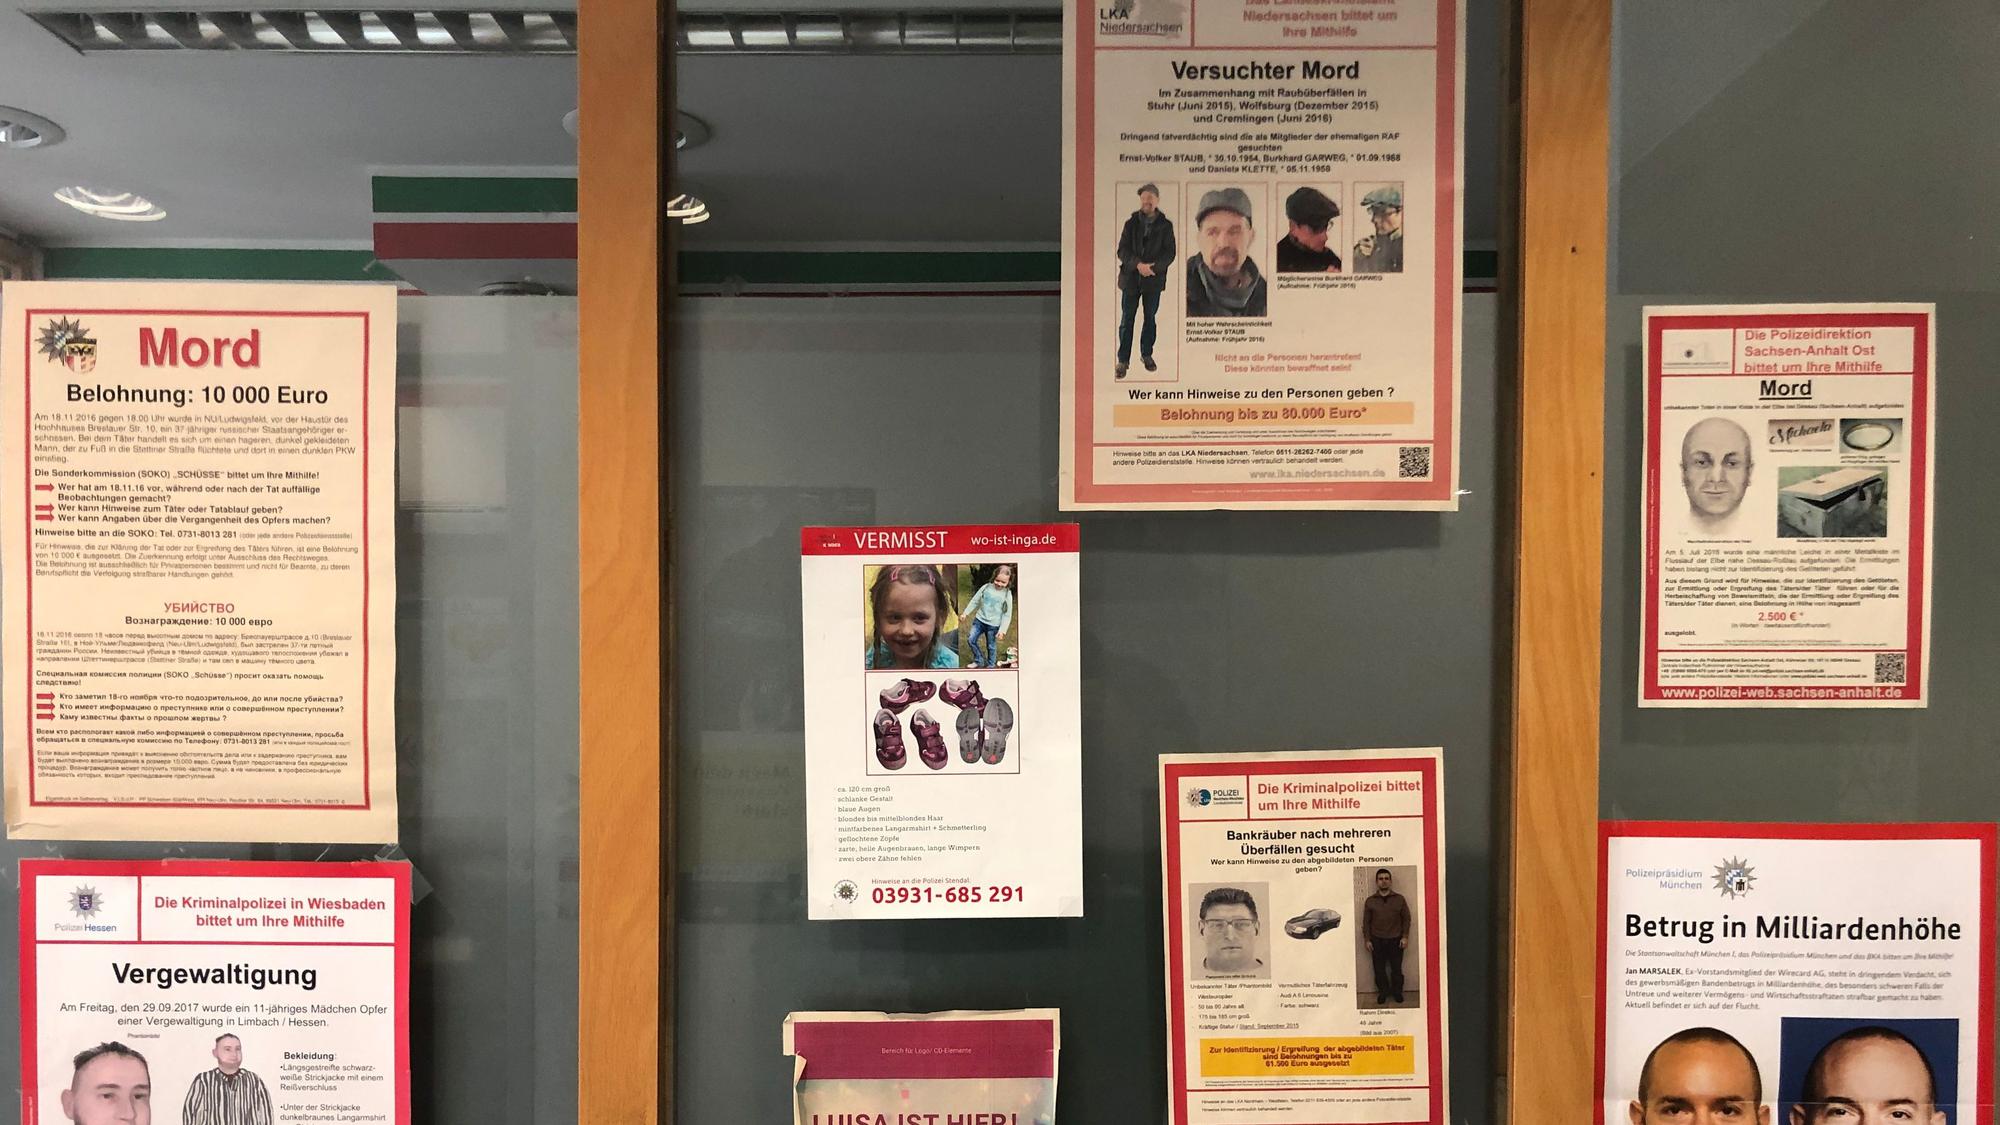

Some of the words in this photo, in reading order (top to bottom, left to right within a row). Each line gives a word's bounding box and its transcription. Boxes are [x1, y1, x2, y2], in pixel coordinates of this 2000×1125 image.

[1100, 8, 1130, 19] LKA
[1242, 8, 1338, 23] Niedersachsen
[1341, 8, 1374, 23] bittet
[1377, 8, 1398, 23] um
[1099, 22, 1183, 33] Niedersachsen
[1282, 24, 1307, 40] Ihre
[1310, 24, 1358, 40] Mithilfe
[1171, 61, 1296, 80] Versuchter
[1302, 60, 1359, 80] Mord
[1157, 88, 1172, 98] Im
[1174, 88, 1256, 100] Zusammenhang
[1258, 88, 1275, 97] mit
[1277, 88, 1355, 98] Raubüberfällen
[1357, 88, 1367, 97] in
[1147, 101, 1175, 110] Stuhr
[1178, 101, 1203, 111] (Juni
[1239, 100, 1291, 113] Wolfsburg
[1294, 100, 1349, 110] (Dezember
[1351, 100, 1379, 110] 2015)
[1193, 114, 1213, 123] und
[1216, 114, 1274, 125] Cremlingen
[1277, 114, 1302, 124] (Juni
[1744, 328, 1766, 342] Die
[1770, 327, 1872, 342] Polizeidirektion
[139, 327, 260, 367] Mord
[1744, 345, 1848, 357] Sachsen-Anhalt
[1852, 344, 1875, 356] Ost
[1743, 361, 1778, 374] bittet
[1781, 361, 1802, 373] um
[1806, 361, 1832, 373] Ihre
[1834, 360, 1884, 373] Mithilfe
[1128, 389, 1152, 400] Wer
[1155, 389, 1184, 400] kann
[1187, 388, 1241, 400] Hinweise
[1244, 390, 1258, 399] zu
[1261, 388, 1283, 399] den
[1287, 387, 1343, 399] Personen
[1347, 387, 1383, 400] geben
[1387, 386, 1394, 397] ?
[1760, 379, 1812, 396] Mord
[67, 384, 193, 408] Belohnung:
[202, 385, 226, 404] 10
[232, 386, 270, 404] 000
[278, 385, 328, 404] Euro
[1160, 408, 1235, 423] Belohnung
[1238, 407, 1259, 420] bis
[1262, 410, 1278, 420] zu
[1282, 407, 1326, 420] 80.000
[34, 468, 50, 477] Die
[52, 469, 136, 478] Sonderkommission
[137, 470, 170, 479] (SOKO)
[227, 471, 249, 479] bittet
[266, 471, 283, 480] Ihre
[285, 471, 320, 479] Mithilfe!
[35, 528, 75, 537] Hinweise
[77, 528, 97, 537] bitte
[112, 529, 126, 537] die
[127, 529, 157, 538] SOKO:
[160, 529, 175, 538] Tel.
[222, 530, 237, 539] 281
[854, 531, 948, 549] VERMISST
[971, 533, 1057, 548] wo-ist-inga.de
[164, 601, 235, 614] УБИЙСТВО
[125, 616, 212, 627] Вознаграждение:
[216, 617, 227, 626] 10
[228, 617, 246, 626] 000
[248, 619, 273, 628] евро
[1757, 611, 1787, 622] 2.500
[1788, 611, 1797, 622] €
[1661, 687, 1902, 700] www.polizei-web.sachsen-anhalt.de
[848, 785, 860, 793] 120
[873, 785, 891, 794] groß
[1212, 788, 1240, 797] POLIZEI
[1258, 783, 1279, 795] Die
[1283, 781, 1382, 795] Kriminalpolizei
[1387, 780, 1421, 792] bittet
[1258, 802, 1279, 811] um
[1282, 799, 1308, 810] Ihre
[1312, 797, 1361, 810] Mithilfe
[1227, 830, 1297, 841] Bankräuber
[1300, 828, 1330, 839] nach
[1333, 828, 1391, 839] mehreren
[1241, 842, 1302, 856] Überfällen
[1306, 843, 1355, 857] gesucht
[1626, 868, 1703, 879] Polizeipräsidium
[1659, 880, 1702, 890] München
[872, 886, 982, 904] 03931-685
[989, 886, 1023, 903] 291
[155, 896, 178, 909] Die
[182, 896, 286, 911] Kriminalpolizei
[291, 897, 304, 910] in
[307, 897, 386, 910] Wiesbaden
[54, 923, 83, 932] Polizei
[84, 923, 117, 932] Hessen
[196, 914, 232, 927] bittet
[236, 917, 258, 927] um
[262, 915, 289, 927] Ihre
[293, 915, 345, 928] Mithilfe
[1626, 914, 1715, 944] Betrug
[1723, 914, 1746, 938] in
[1756, 915, 1961, 941] Milliardenhöhe
[112, 963, 317, 991] Vergewaltigung
[1625, 967, 1638, 975] Jan
[59, 1002, 78, 1012] Am
[79, 1002, 118, 1015] Freitag,
[120, 1003, 140, 1013] den
[142, 1002, 200, 1013] 29.09.2017
[201, 1003, 233, 1013] wurde
[235, 1005, 252, 1013] ein
[254, 1003, 308, 1016] 11-jähriges
[310, 1004, 357, 1014] Mädchen
[359, 1004, 388, 1016] Opfer
[1624, 1001, 1651, 1009] Aktuell
[1652, 1001, 1682, 1009] befindet
[1708, 1002, 1720, 1010] auf
[1722, 1002, 1734, 1010] der
[117, 1018, 143, 1026] einer
[145, 1016, 224, 1028] Vergewaltigung
[226, 1018, 235, 1026] in
[238, 1017, 280, 1027] Limbach
[282, 1017, 286, 1026] /
[288, 1017, 328, 1027] Hessen.
[284, 1051, 337, 1062] Bekleidung:
[881, 1047, 904, 1055] Bereich
